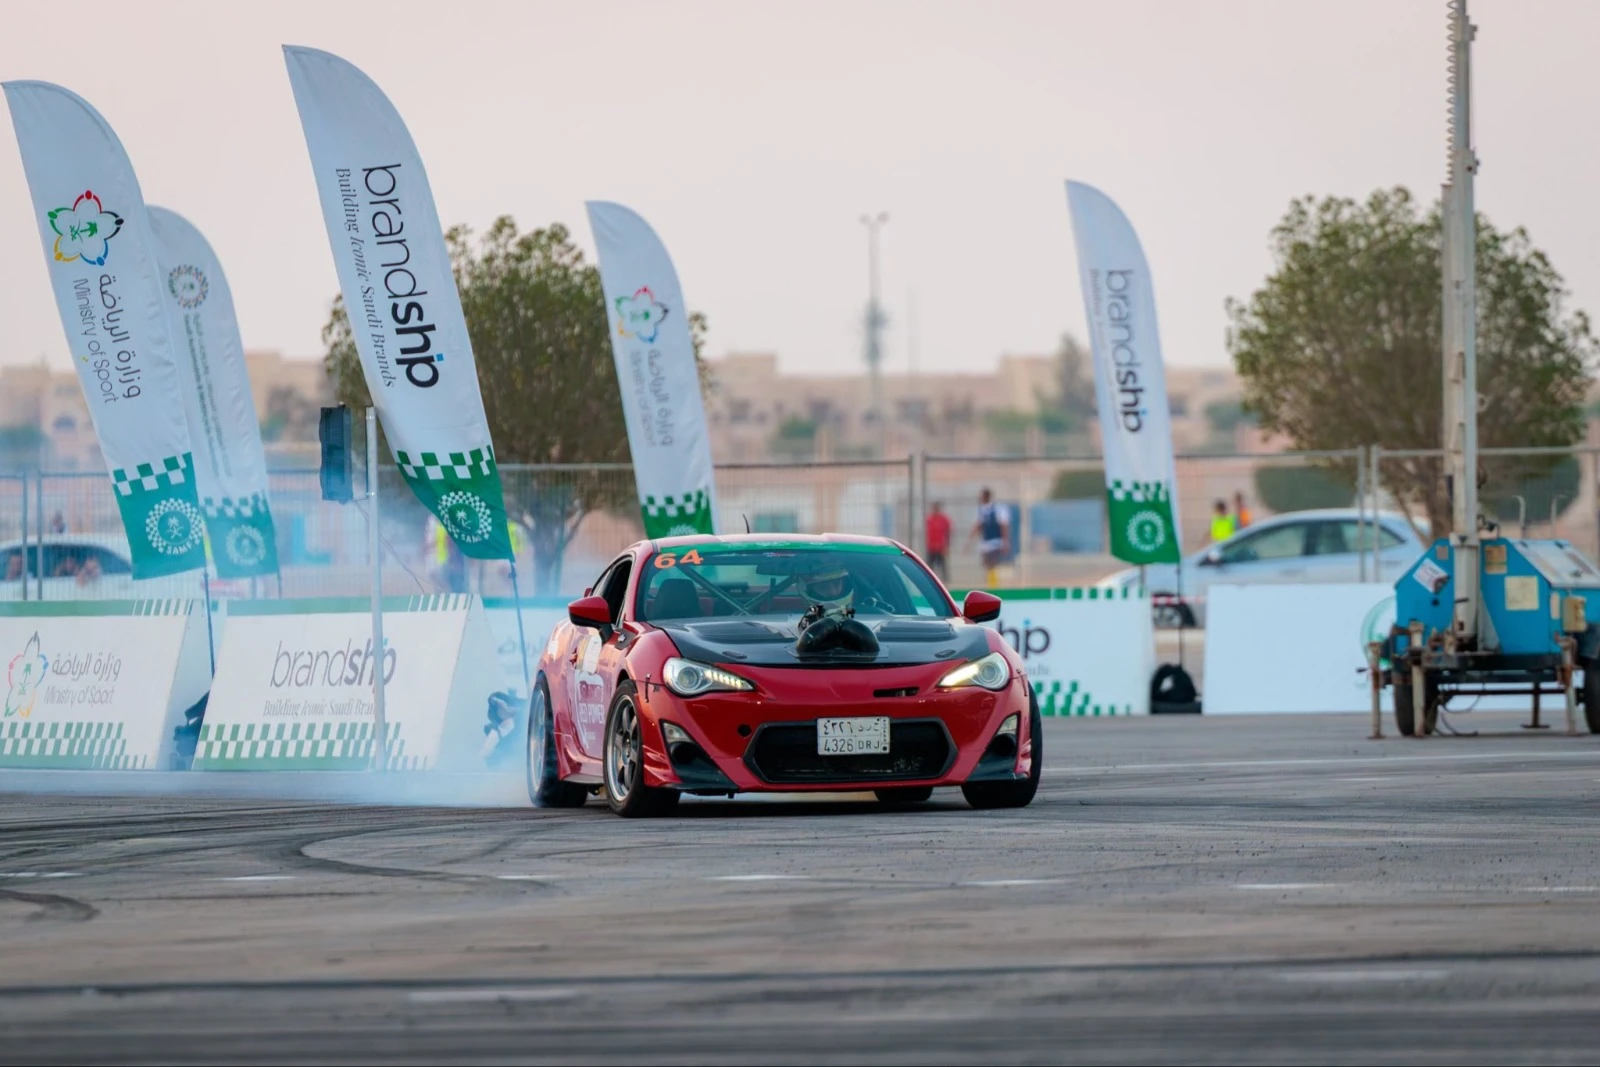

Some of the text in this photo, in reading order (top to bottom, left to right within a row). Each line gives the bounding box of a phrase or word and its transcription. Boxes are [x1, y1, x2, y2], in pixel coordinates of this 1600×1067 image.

[335, 168, 397, 388] Building Iconic Saudi Brands
[73, 278, 119, 404] Ministry of Sport
[99, 274, 141, 399] وزارة الرياضة
[166, 541, 192, 555] SAMF
[654, 549, 704, 569] 64
[52, 652, 122, 681] وزارة الرياضة
[44, 685, 115, 708] Ministry of Sport
[262, 700, 300, 718] Building
[300, 700, 328, 716] Iconic
[328, 699, 354, 716] Saudi
[824, 738, 854, 752] 4326
